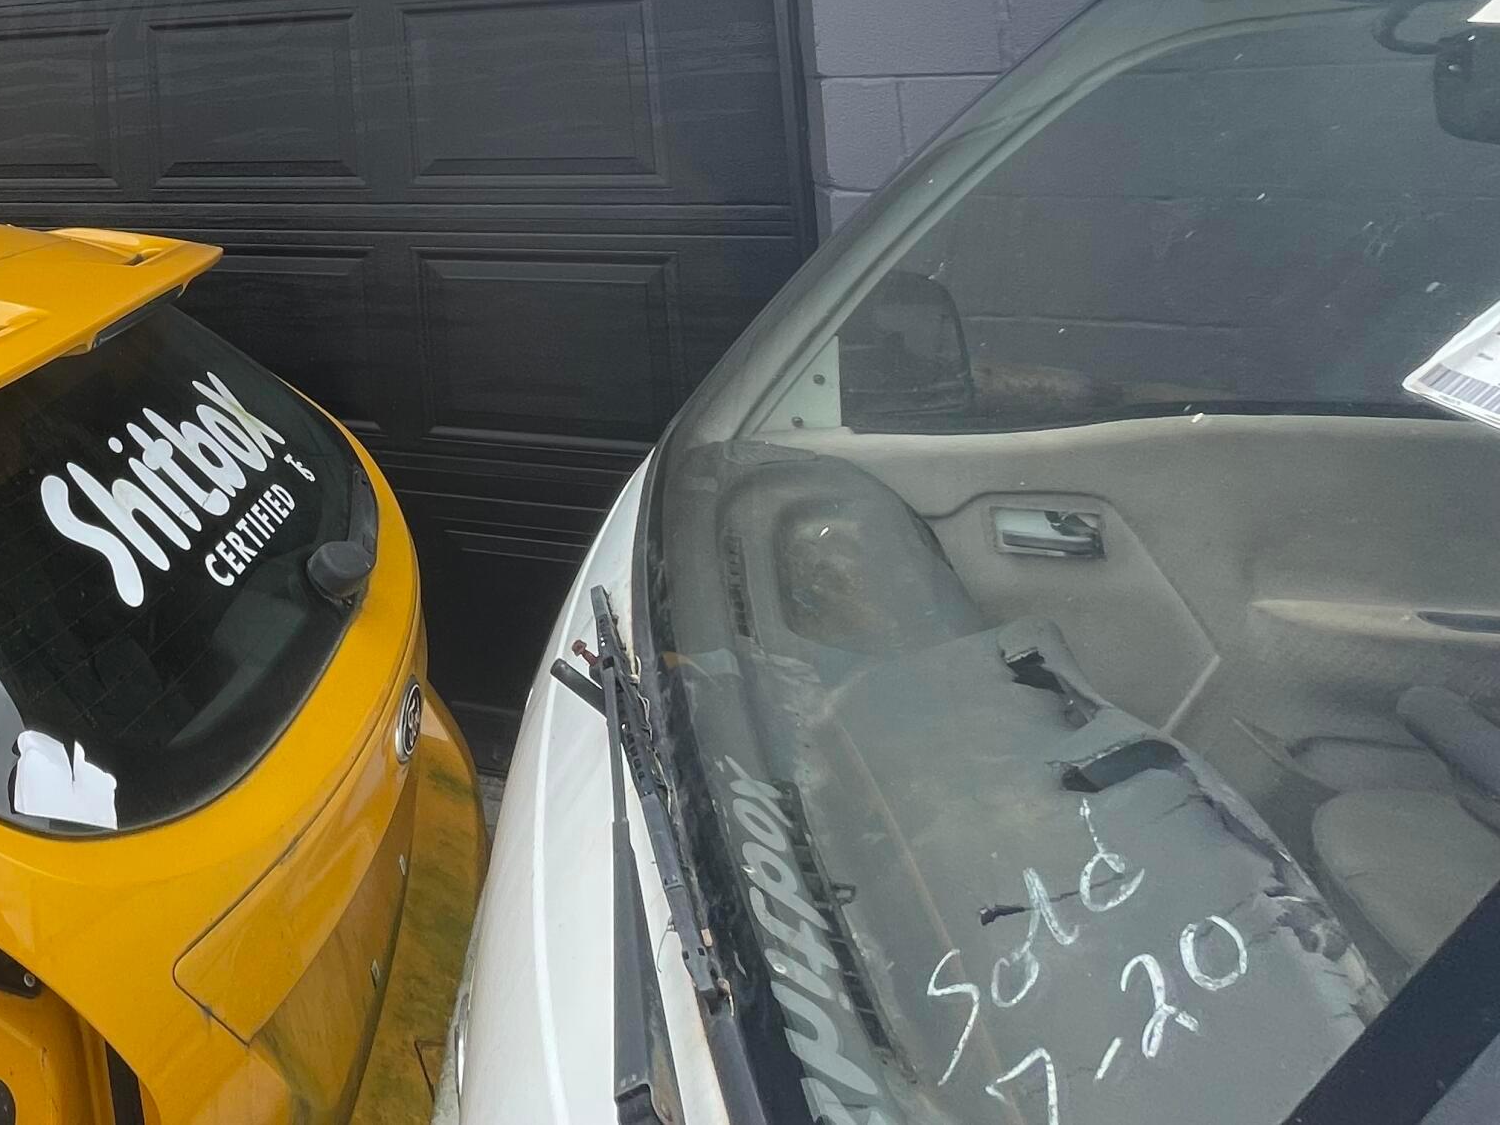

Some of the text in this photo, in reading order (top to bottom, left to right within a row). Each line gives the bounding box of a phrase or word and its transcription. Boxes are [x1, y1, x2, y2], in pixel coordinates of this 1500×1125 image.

[40, 371, 285, 608] Shitbox
[205, 483, 296, 587] CERTIFIED
[927, 798, 1145, 1087] Sold
